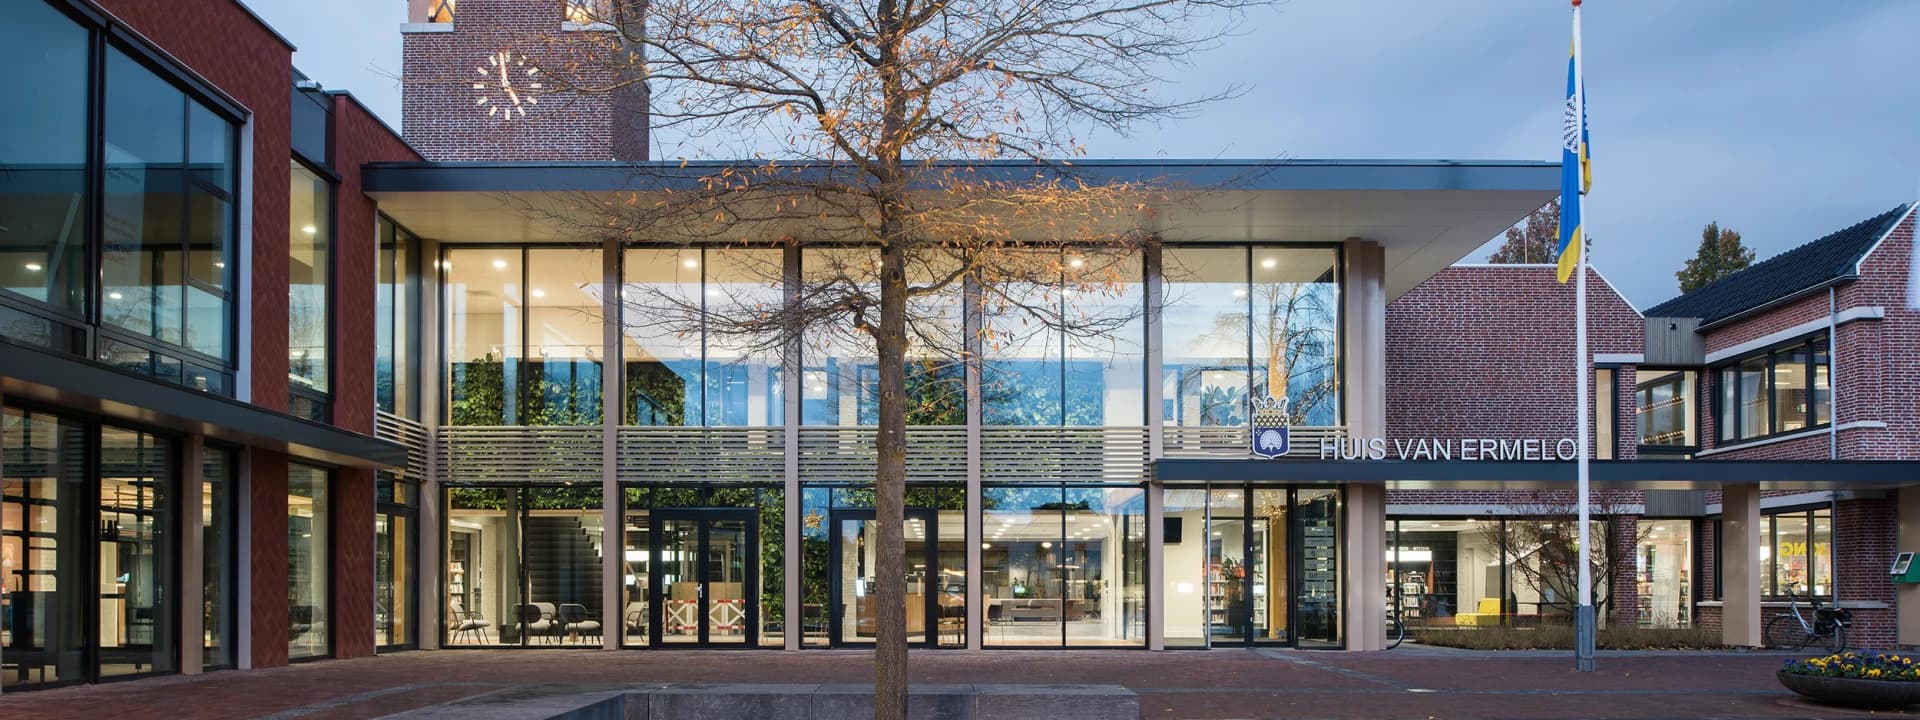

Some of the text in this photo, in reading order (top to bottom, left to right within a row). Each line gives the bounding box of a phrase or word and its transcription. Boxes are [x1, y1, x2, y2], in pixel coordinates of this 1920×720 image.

[1320, 438, 1577, 460] HUIS VAN ERMELO
